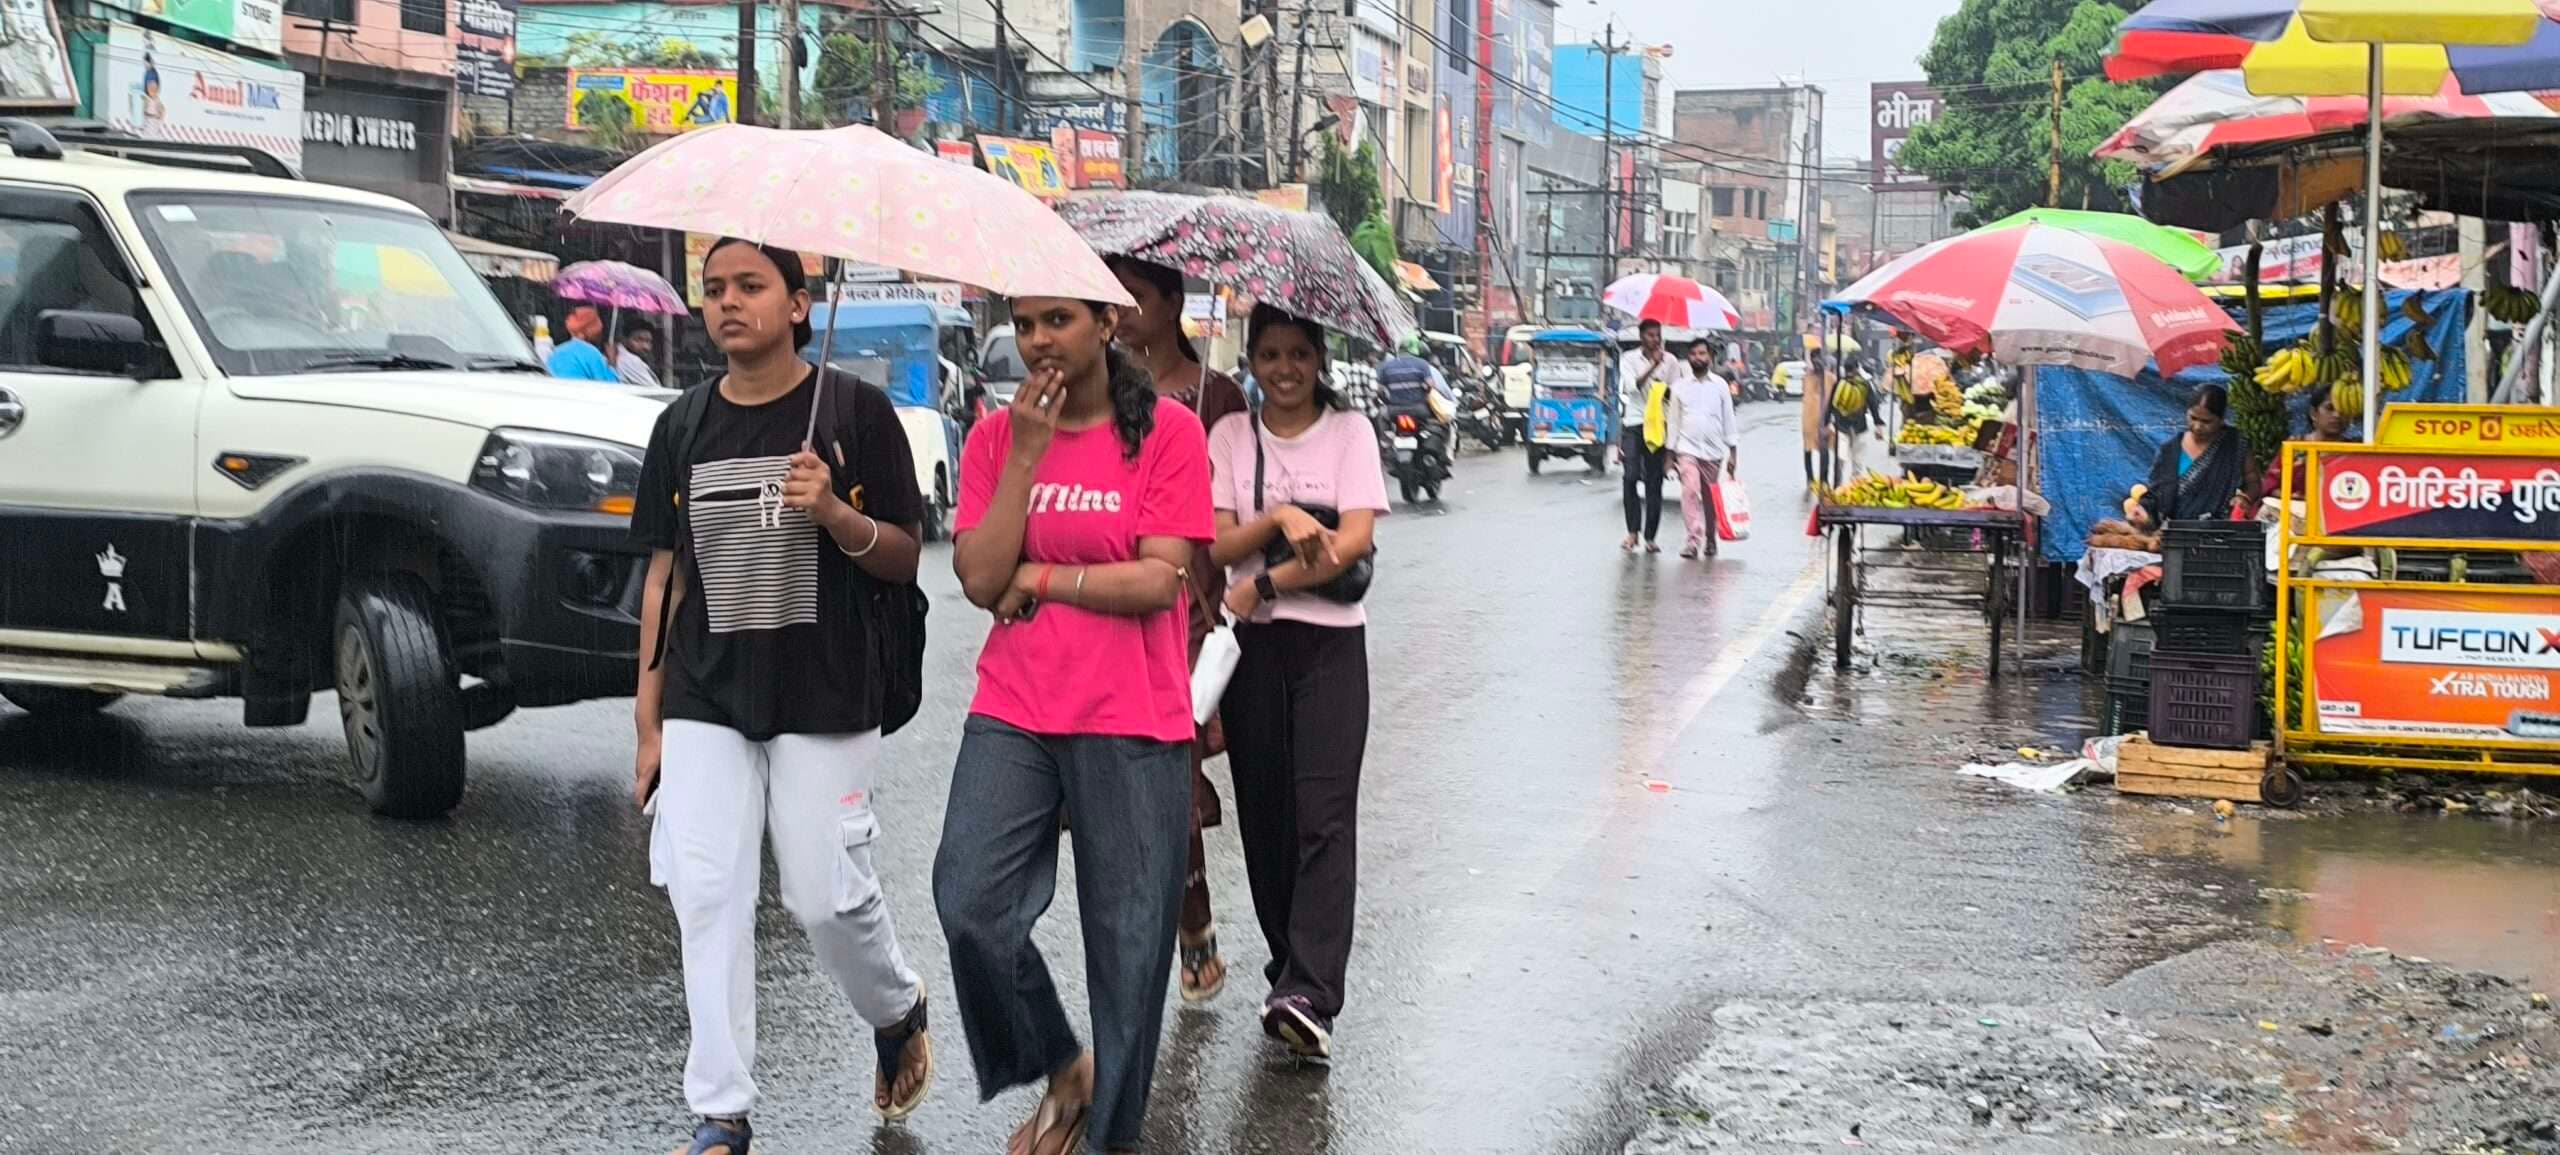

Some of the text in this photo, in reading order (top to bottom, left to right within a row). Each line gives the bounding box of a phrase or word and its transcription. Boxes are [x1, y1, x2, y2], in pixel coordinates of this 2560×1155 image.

[190, 70, 242, 107] Amul
[356, 116, 416, 150] SWEETS
[2415, 419, 2472, 435] STOP
[1027, 482, 1121, 515] ffline
[2378, 466, 2505, 512] गिरिडीह
[2390, 626, 2530, 654] TUFCON
[2490, 680, 2550, 700] TOUGH
